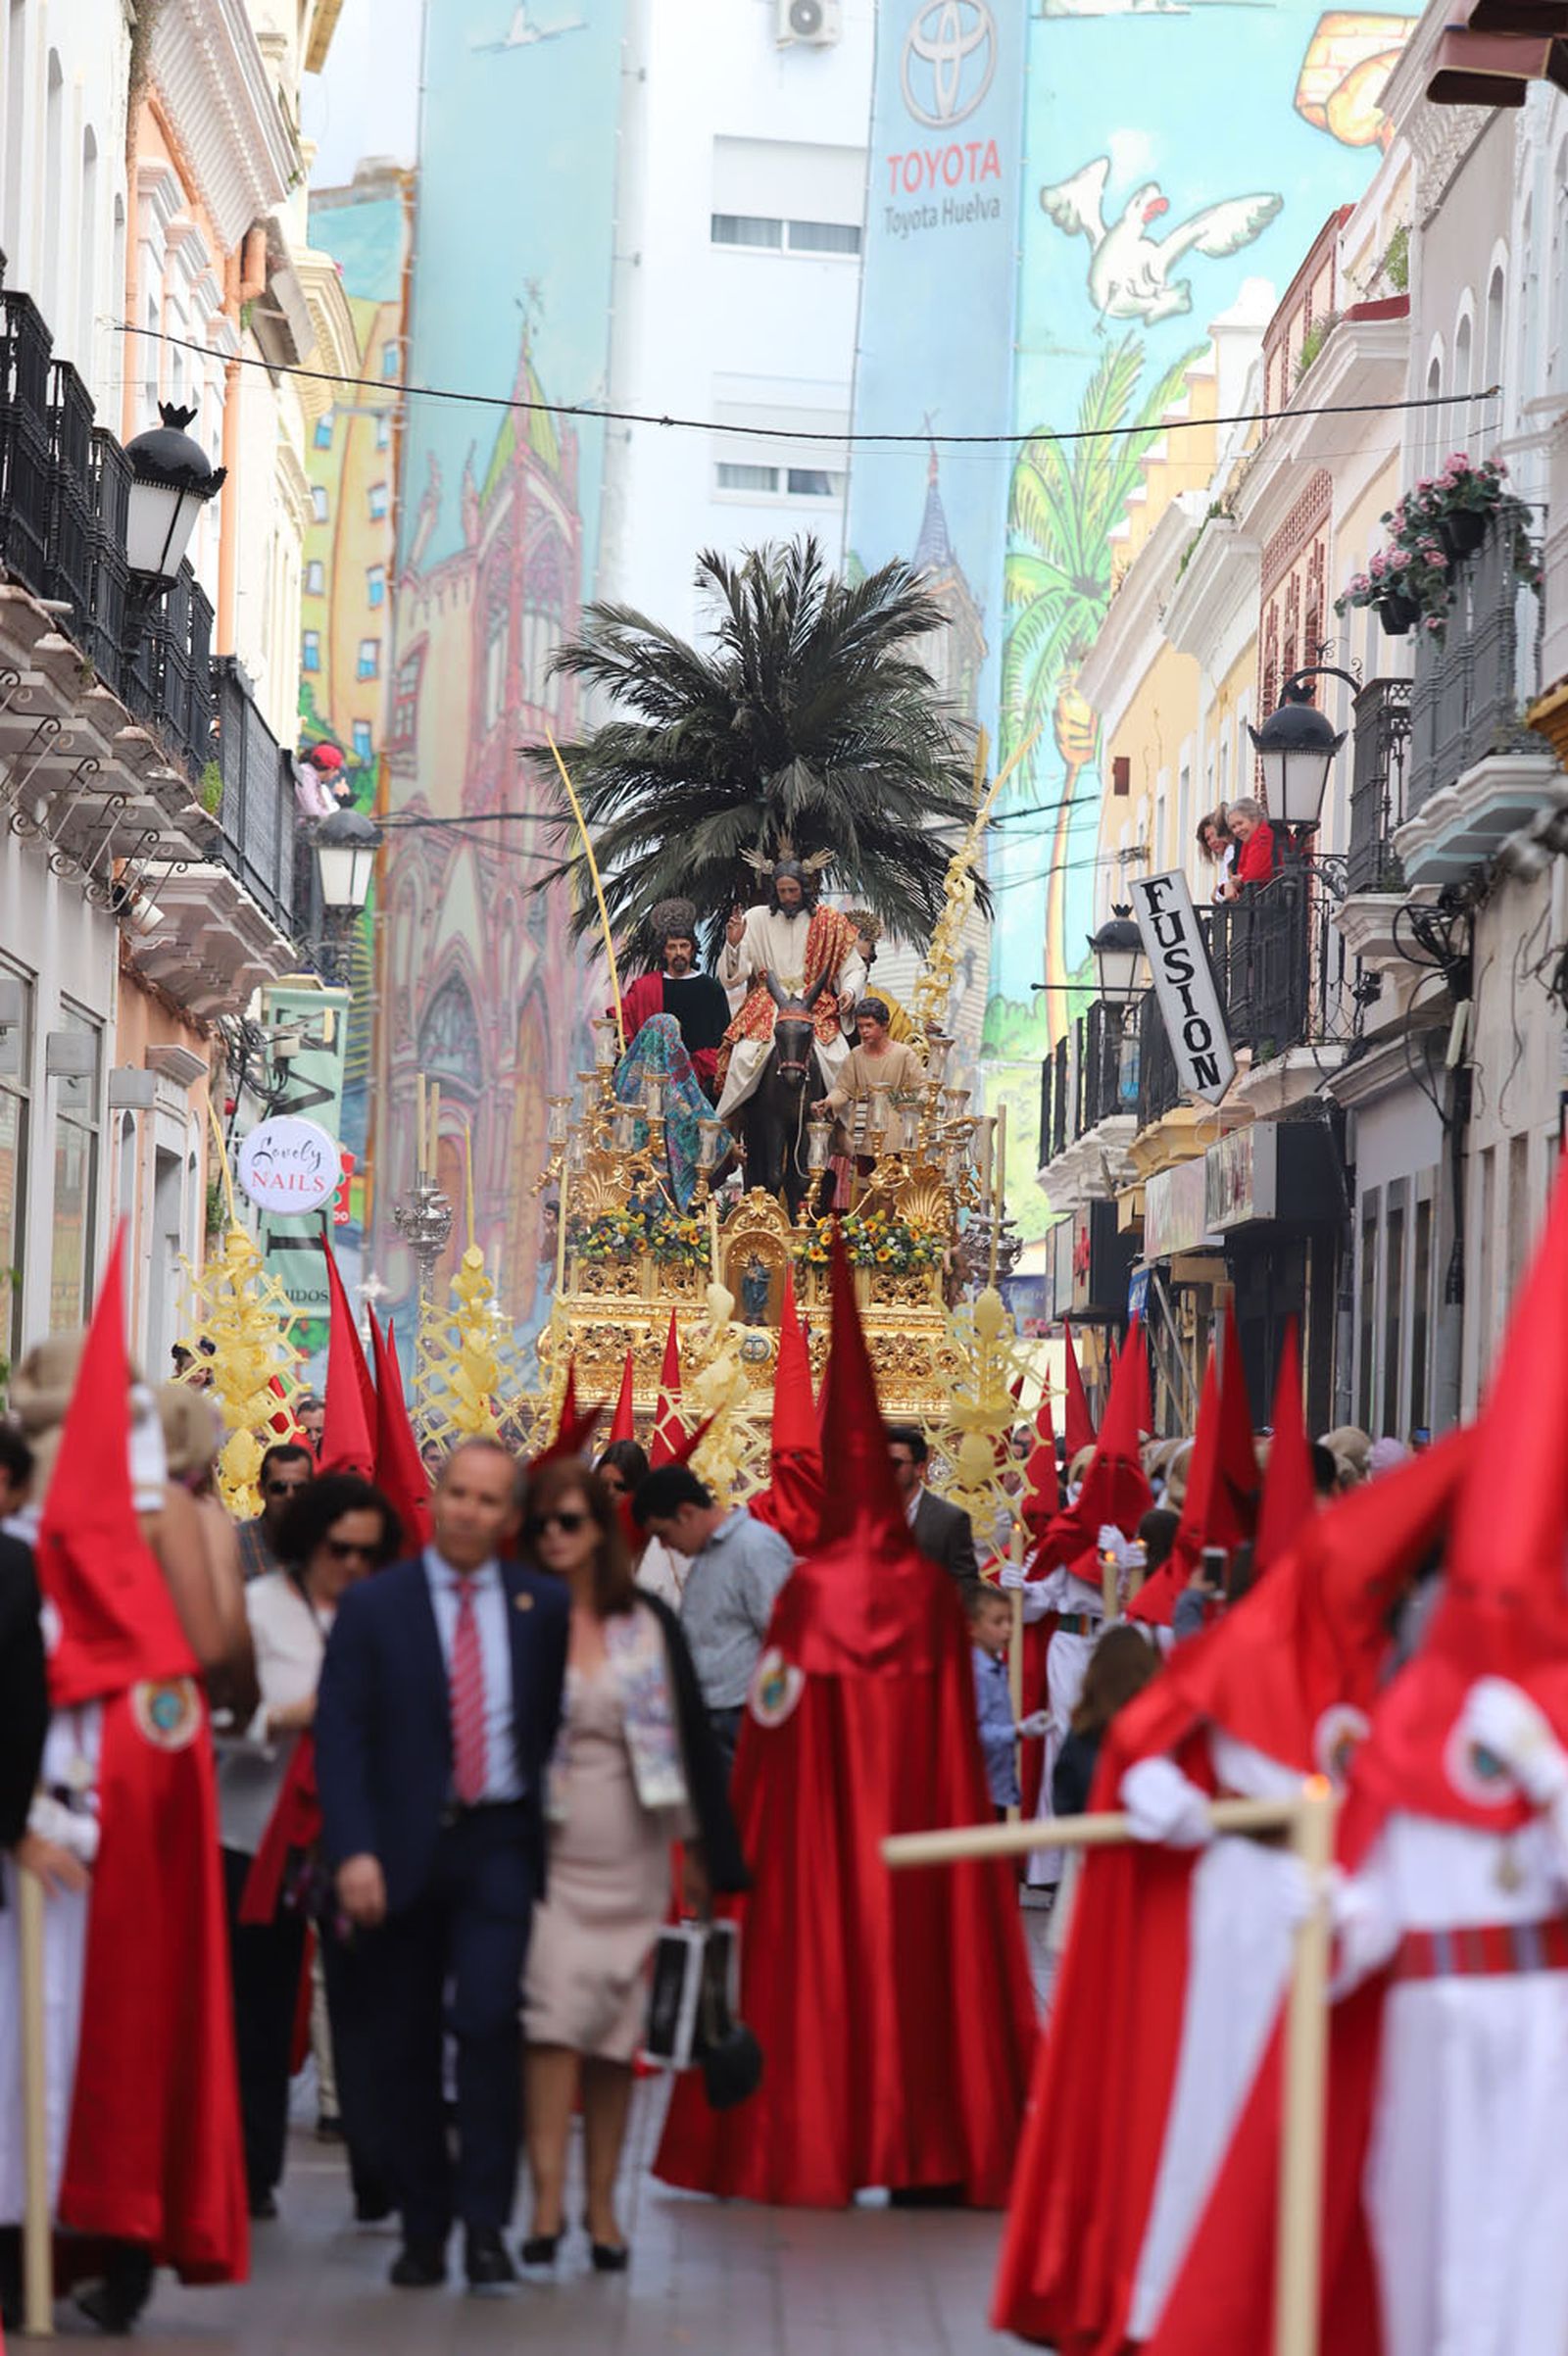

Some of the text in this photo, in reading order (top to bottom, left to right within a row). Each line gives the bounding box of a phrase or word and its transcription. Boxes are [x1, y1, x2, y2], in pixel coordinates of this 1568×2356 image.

[886, 139, 1002, 197] TOYOTA
[884, 194, 1000, 239] Toyota Huelva
[1140, 877, 1222, 1090] FUSION
[251, 1135, 323, 1172] Lovely
[252, 1169, 325, 1193] NAILS
